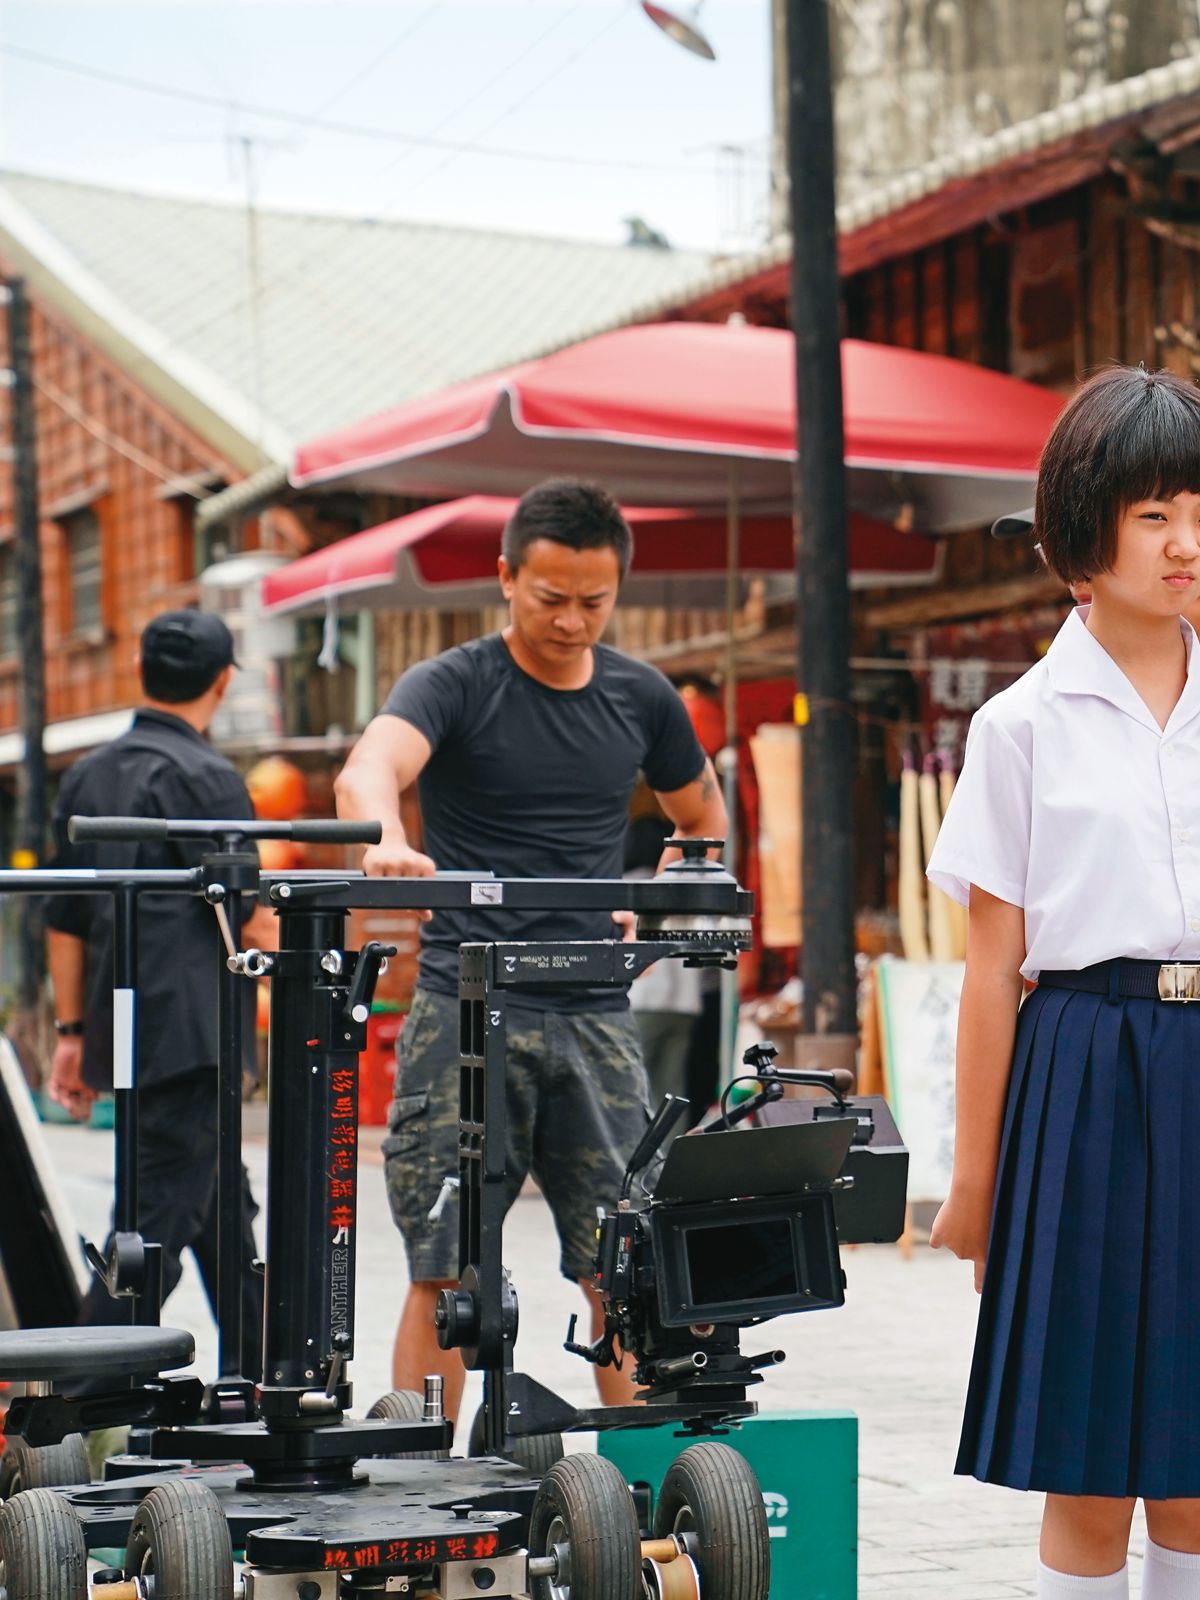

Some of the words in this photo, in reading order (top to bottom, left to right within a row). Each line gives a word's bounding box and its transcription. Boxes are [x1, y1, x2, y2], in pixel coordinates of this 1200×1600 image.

[504, 956, 517, 973] 2
[624, 953, 636, 970] 2
[490, 1010, 501, 1026] 2
[331, 1248, 348, 1340] ANTHER
[508, 1401, 521, 1415] 2
